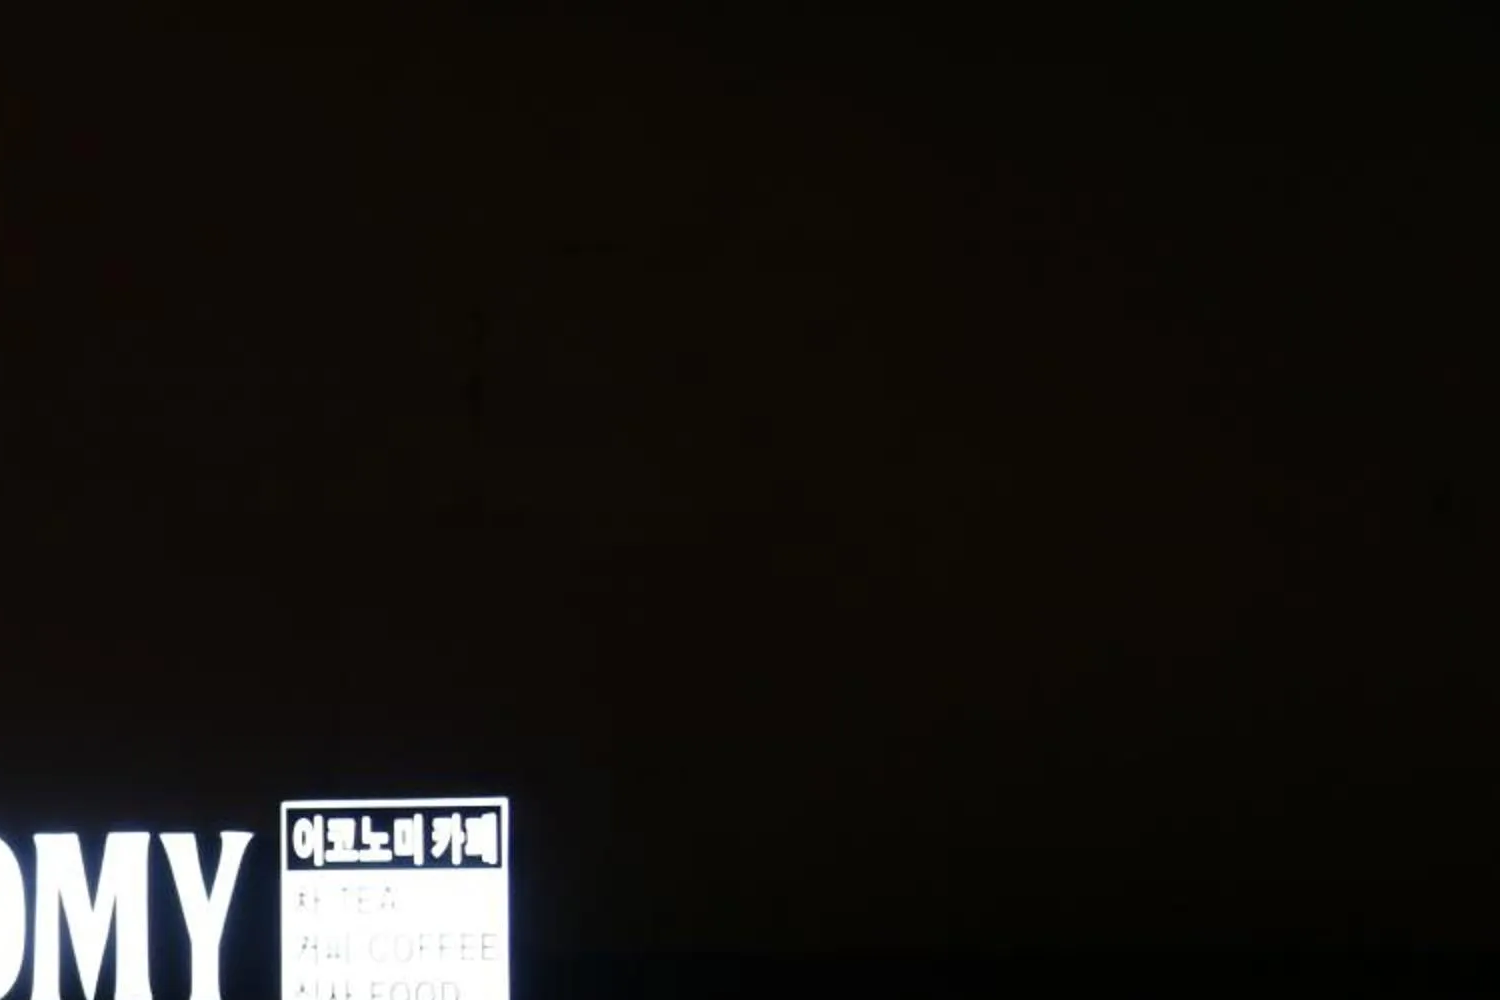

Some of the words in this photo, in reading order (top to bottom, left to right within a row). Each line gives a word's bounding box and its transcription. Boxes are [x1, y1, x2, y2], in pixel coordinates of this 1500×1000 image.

[292, 813, 425, 867] 이코노미
[430, 812, 499, 866] 카페
[368, 931, 499, 964] COFFEE
